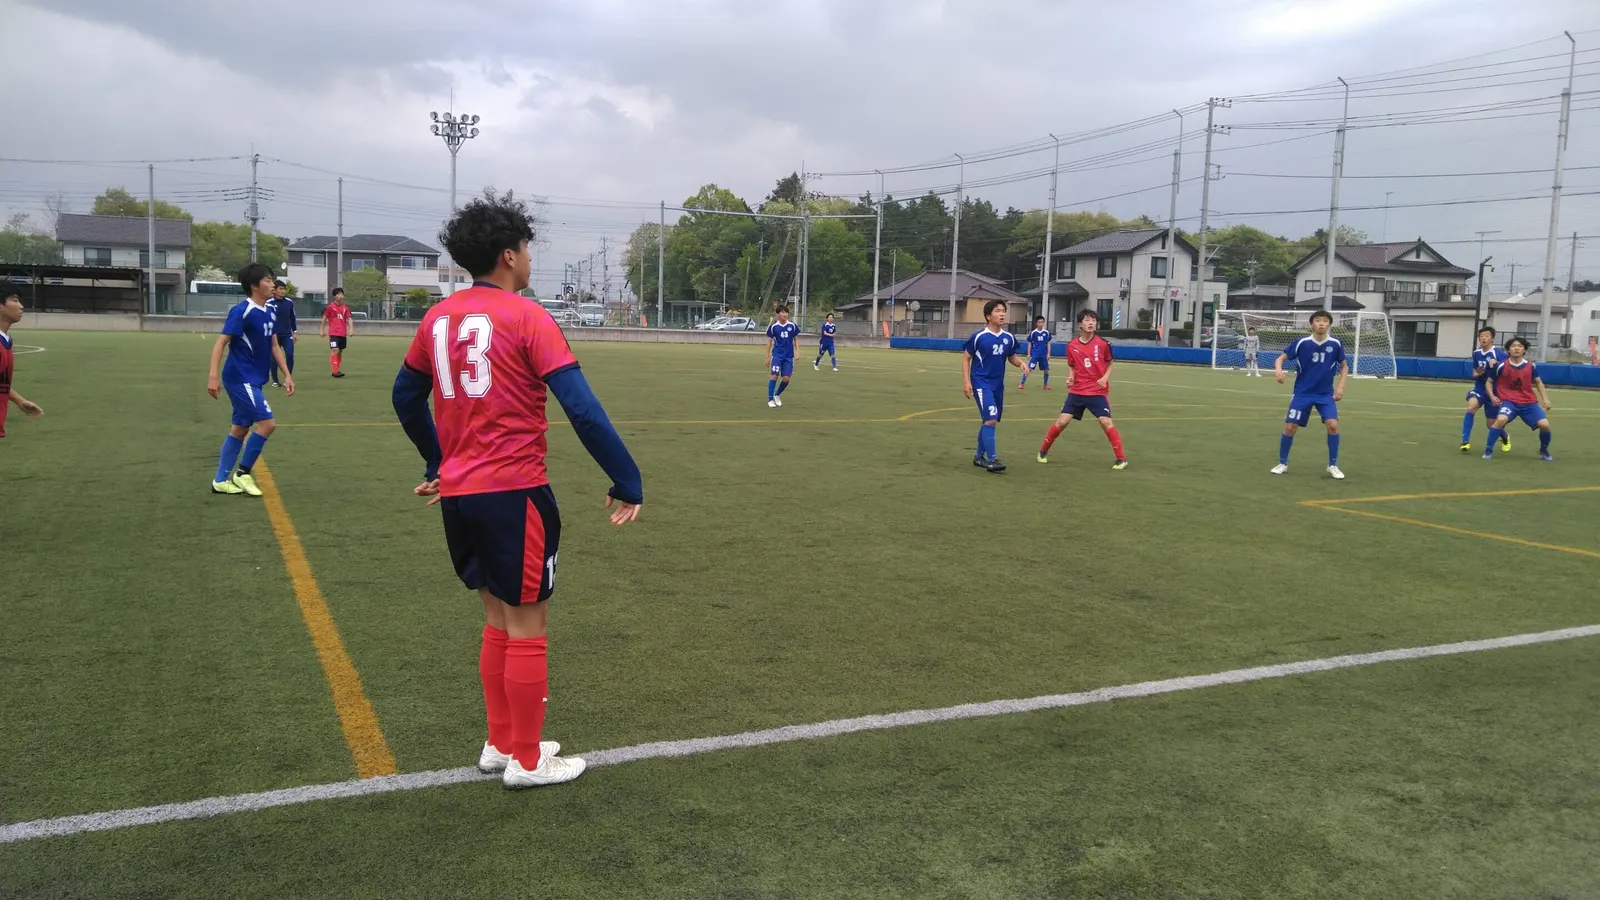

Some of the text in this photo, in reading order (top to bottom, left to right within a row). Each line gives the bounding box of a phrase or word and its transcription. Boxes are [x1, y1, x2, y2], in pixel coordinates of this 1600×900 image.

[780, 331, 789, 339] 43
[992, 344, 1004, 355] 24
[432, 314, 493, 398] 13
[1312, 352, 1325, 363] 31
[1084, 357, 1092, 368] 6
[1288, 409, 1302, 420] 31
[546, 551, 558, 590] 1
